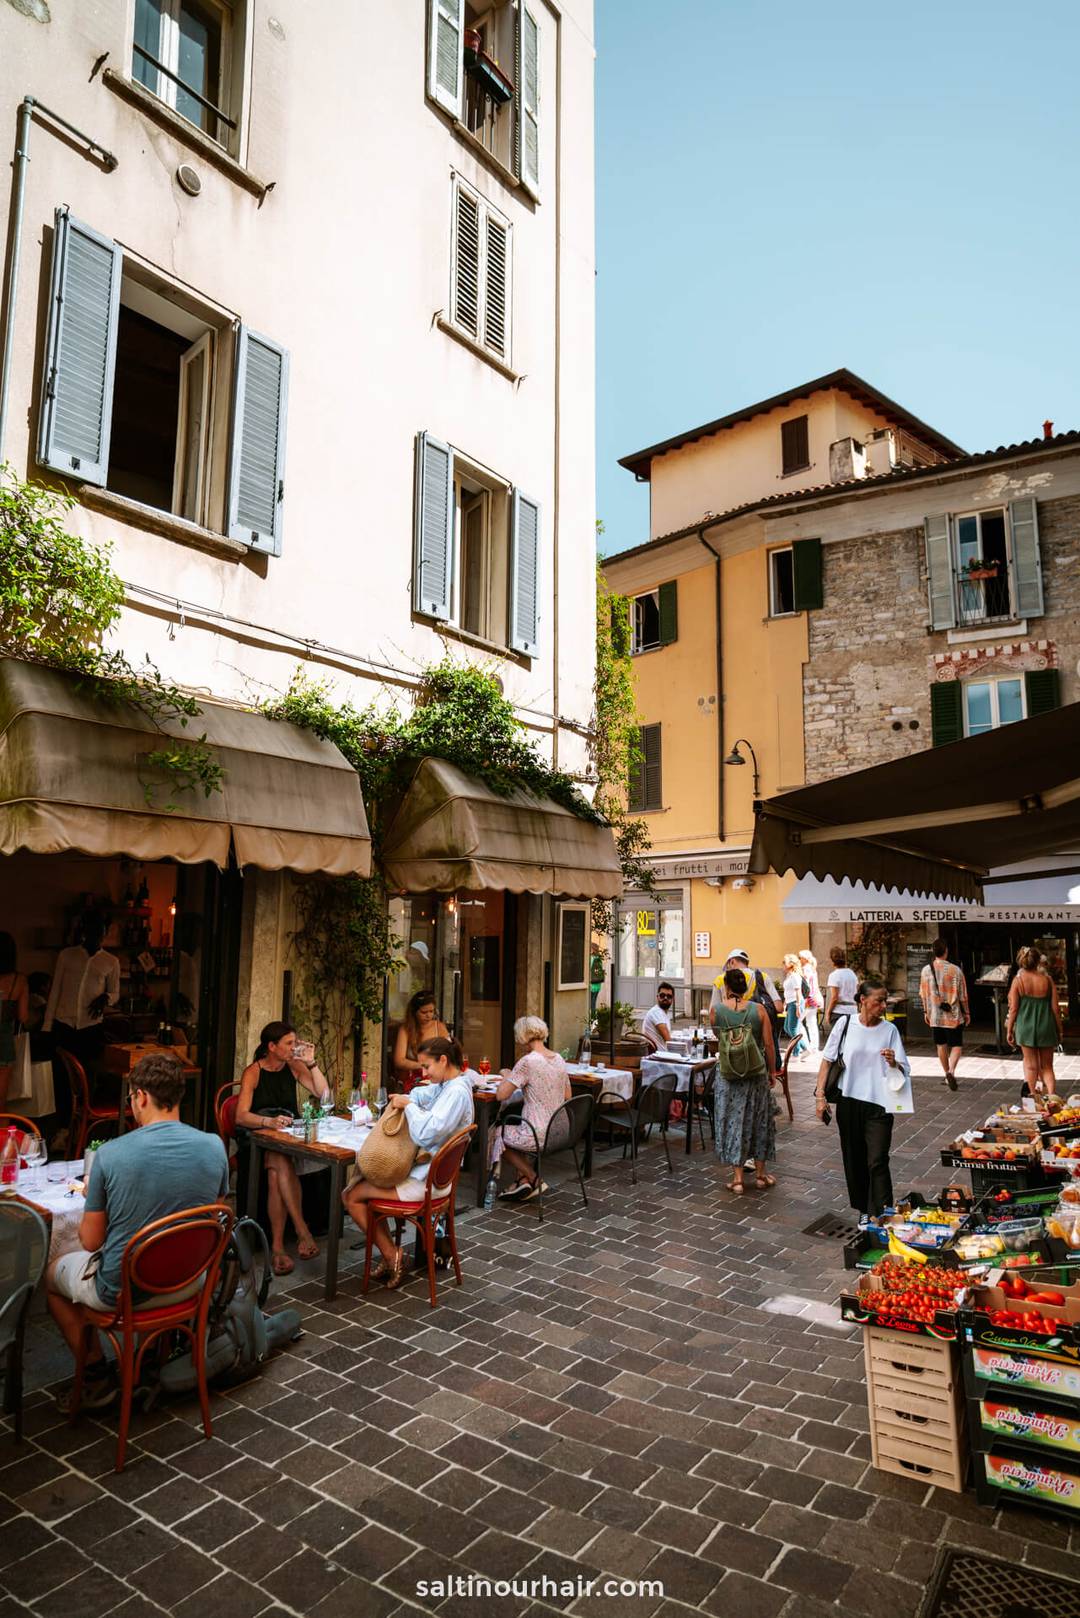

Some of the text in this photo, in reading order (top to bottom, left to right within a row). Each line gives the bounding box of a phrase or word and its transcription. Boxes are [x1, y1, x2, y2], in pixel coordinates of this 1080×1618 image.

[673, 863, 709, 875] frutti
[715, 865, 723, 873] di
[729, 861, 750, 871] mar
[849, 910, 967, 921] LATTERIA S.FEDELE
[989, 911, 1072, 920] RESTAURANT
[951, 1159, 1017, 1171] Prima frutta
[990, 1358, 1062, 1384] Primavera
[996, 1410, 1069, 1440] Primavera
[1001, 1464, 1075, 1497] Primavera
